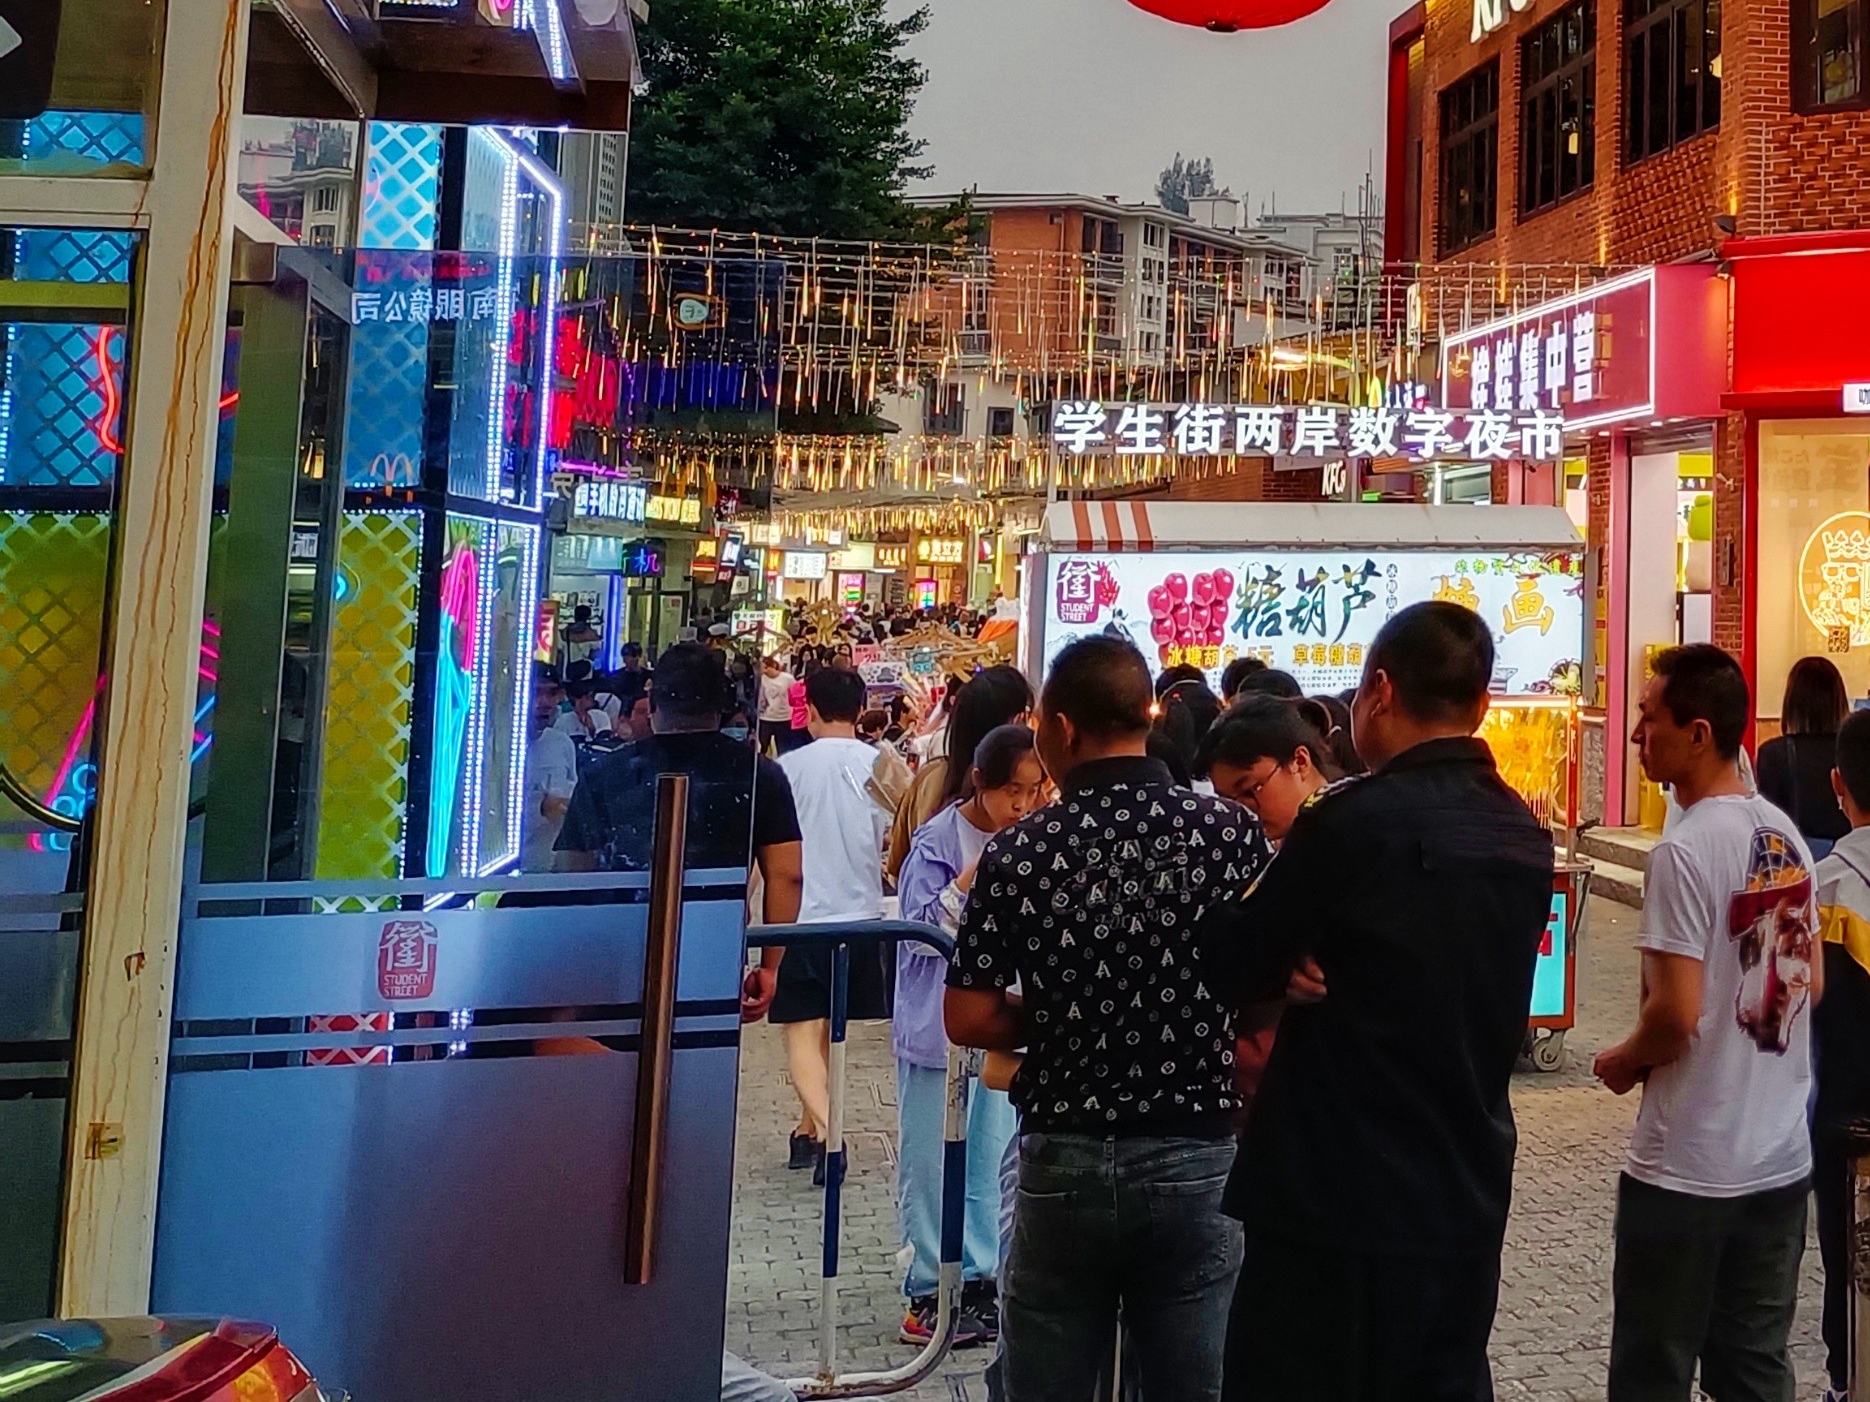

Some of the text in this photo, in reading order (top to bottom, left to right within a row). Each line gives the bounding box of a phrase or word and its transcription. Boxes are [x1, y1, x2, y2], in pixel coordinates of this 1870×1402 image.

[1053, 401, 1565, 460] 学生街两岸数字夜市
[1060, 602, 1095, 613] STUDENT
[1231, 558, 1382, 644] 糖葫芦
[1060, 612, 1088, 623] STREET
[1292, 643, 1369, 667] 草莓糖葫
[383, 973, 428, 986] STUDENT
[383, 985, 418, 997] STREET
